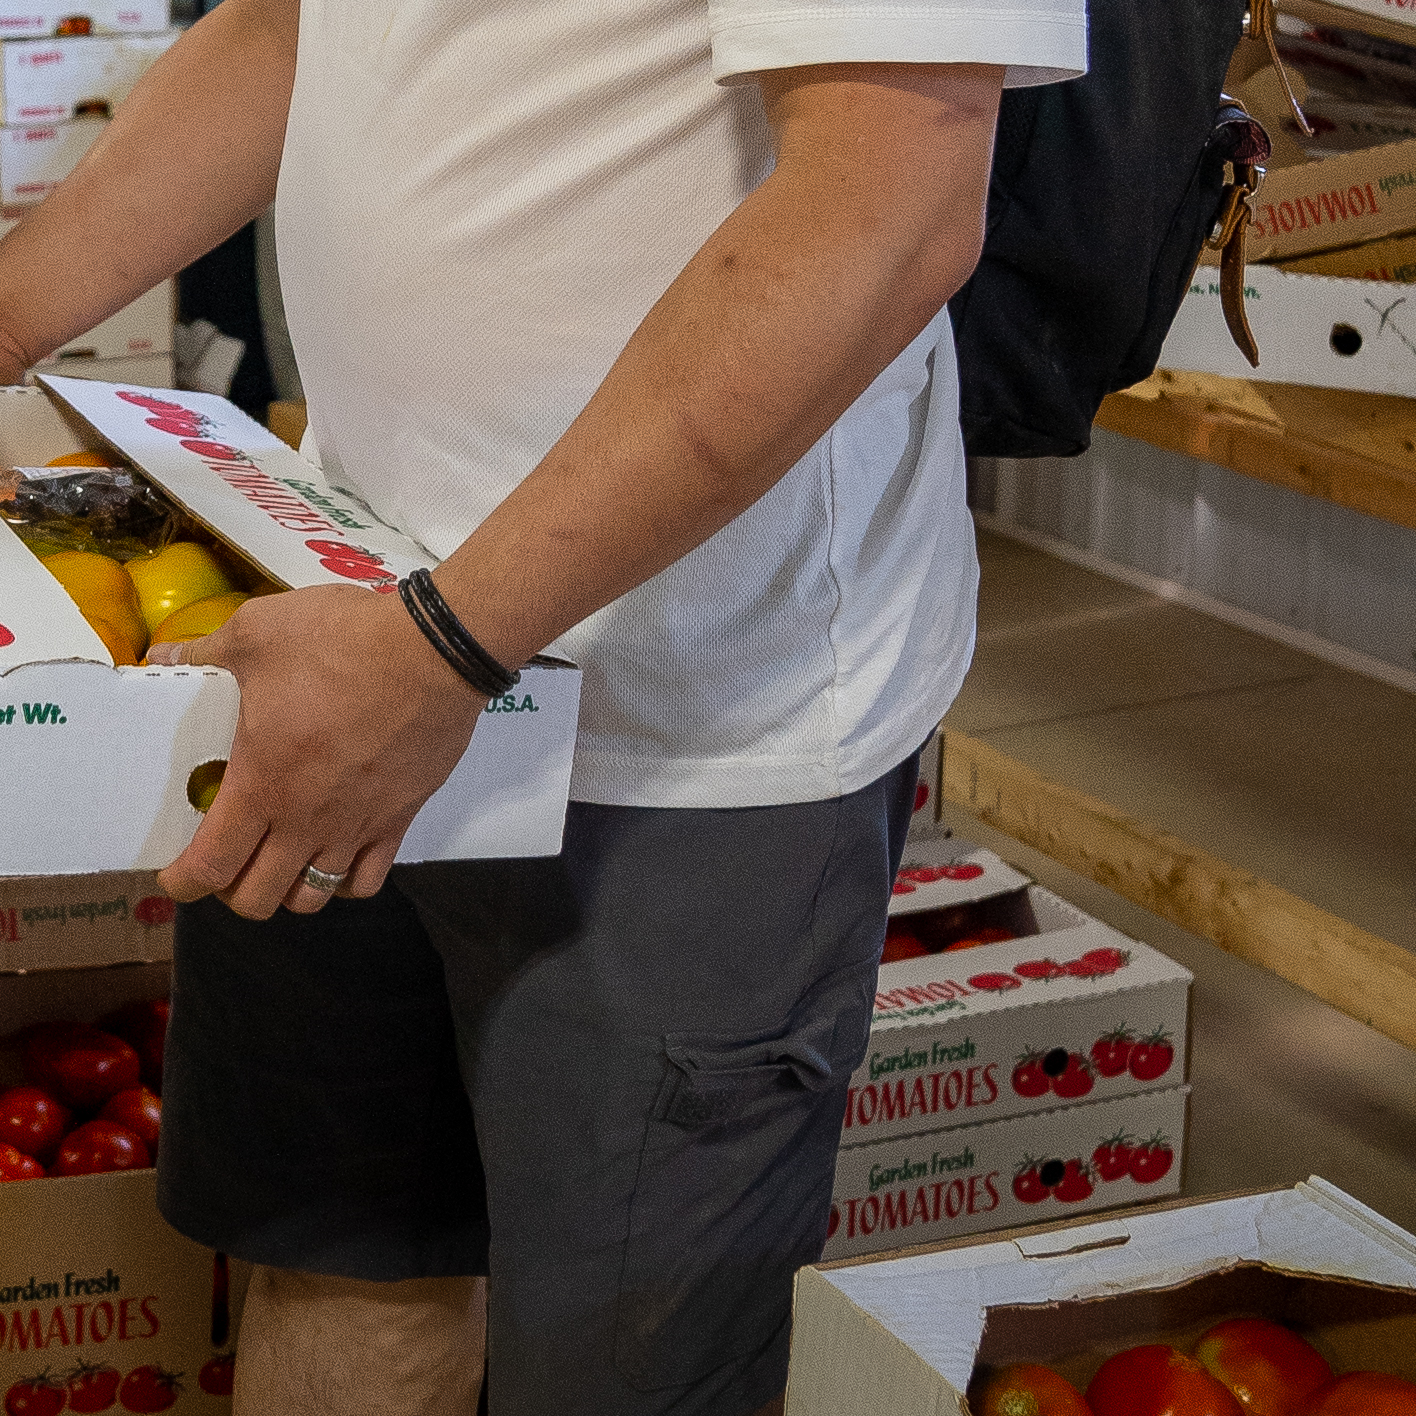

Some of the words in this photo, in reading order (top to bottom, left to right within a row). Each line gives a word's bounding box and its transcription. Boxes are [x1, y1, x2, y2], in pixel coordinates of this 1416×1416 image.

[201, 459, 345, 537] TOMATOES
[22, 702, 68, 725] Wt.
[869, 1047, 929, 1081] Garden
[932, 1037, 976, 1064] Fresh
[843, 1062, 999, 1129] TOMATOES
[868, 1157, 928, 1192] Garden
[931, 1145, 974, 1174] Fresh
[844, 1171, 1000, 1239] TOMATOES
[64, 1268, 120, 1297] Fresh
